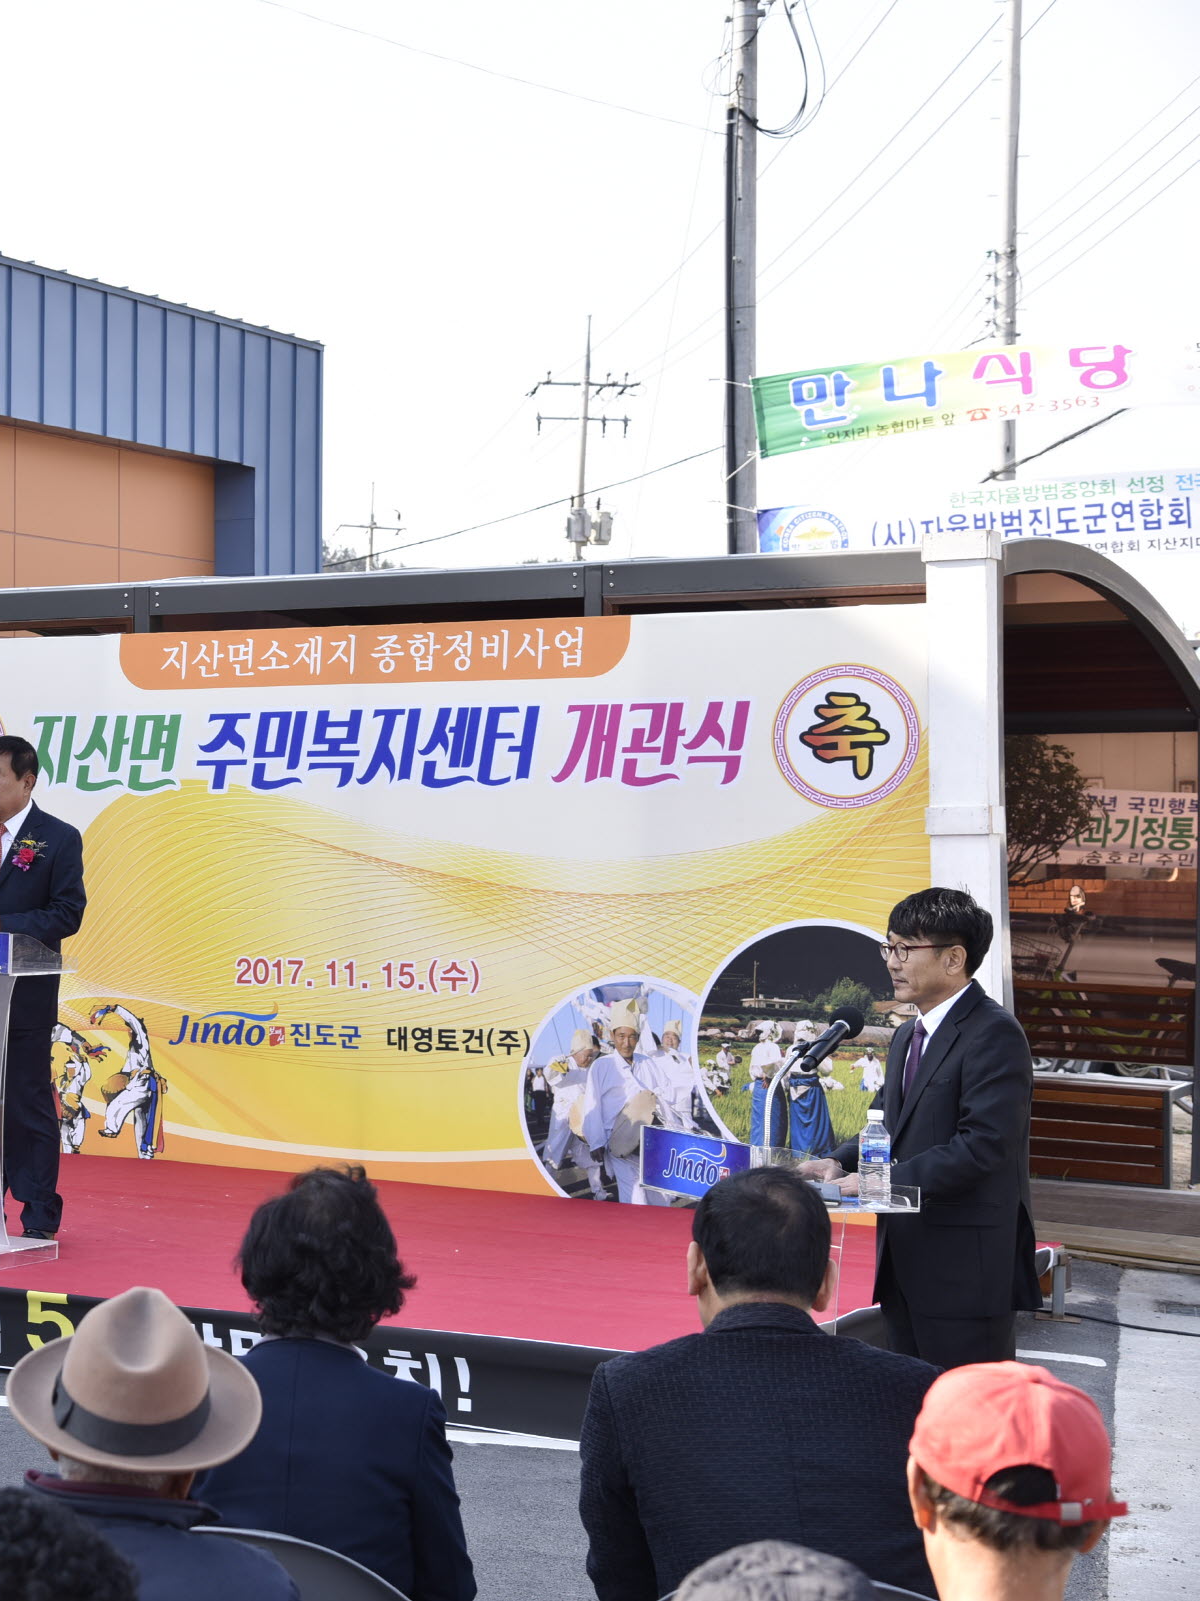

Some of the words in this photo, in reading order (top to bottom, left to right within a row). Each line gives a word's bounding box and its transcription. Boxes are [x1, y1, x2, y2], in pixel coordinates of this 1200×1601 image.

[876, 415, 936, 437] 농협마트
[941, 412, 957, 426] 앞
[998, 396, 1101, 418] 542-3563
[950, 478, 1117, 509] 한국자율방범중앙회
[1127, 475, 1165, 494] 선정
[160, 634, 357, 681] 지산면소재지
[369, 626, 585, 675] 종합정비사업
[31, 713, 182, 792] 지산면
[196, 706, 541, 791] 주민복지센터
[551, 700, 752, 787] 개관식
[799, 691, 890, 781] 축
[1085, 849, 1145, 866] 송호리
[1155, 852, 1195, 867] 주민
[235, 957, 314, 987] 2017.
[327, 960, 369, 990] 11.
[382, 959, 481, 995] 15.(수)
[169, 1014, 266, 1047] Jindo
[289, 1022, 362, 1050] 진도군
[386, 1025, 531, 1058] 대영토건(주)
[662, 1147, 719, 1187] Jindo
